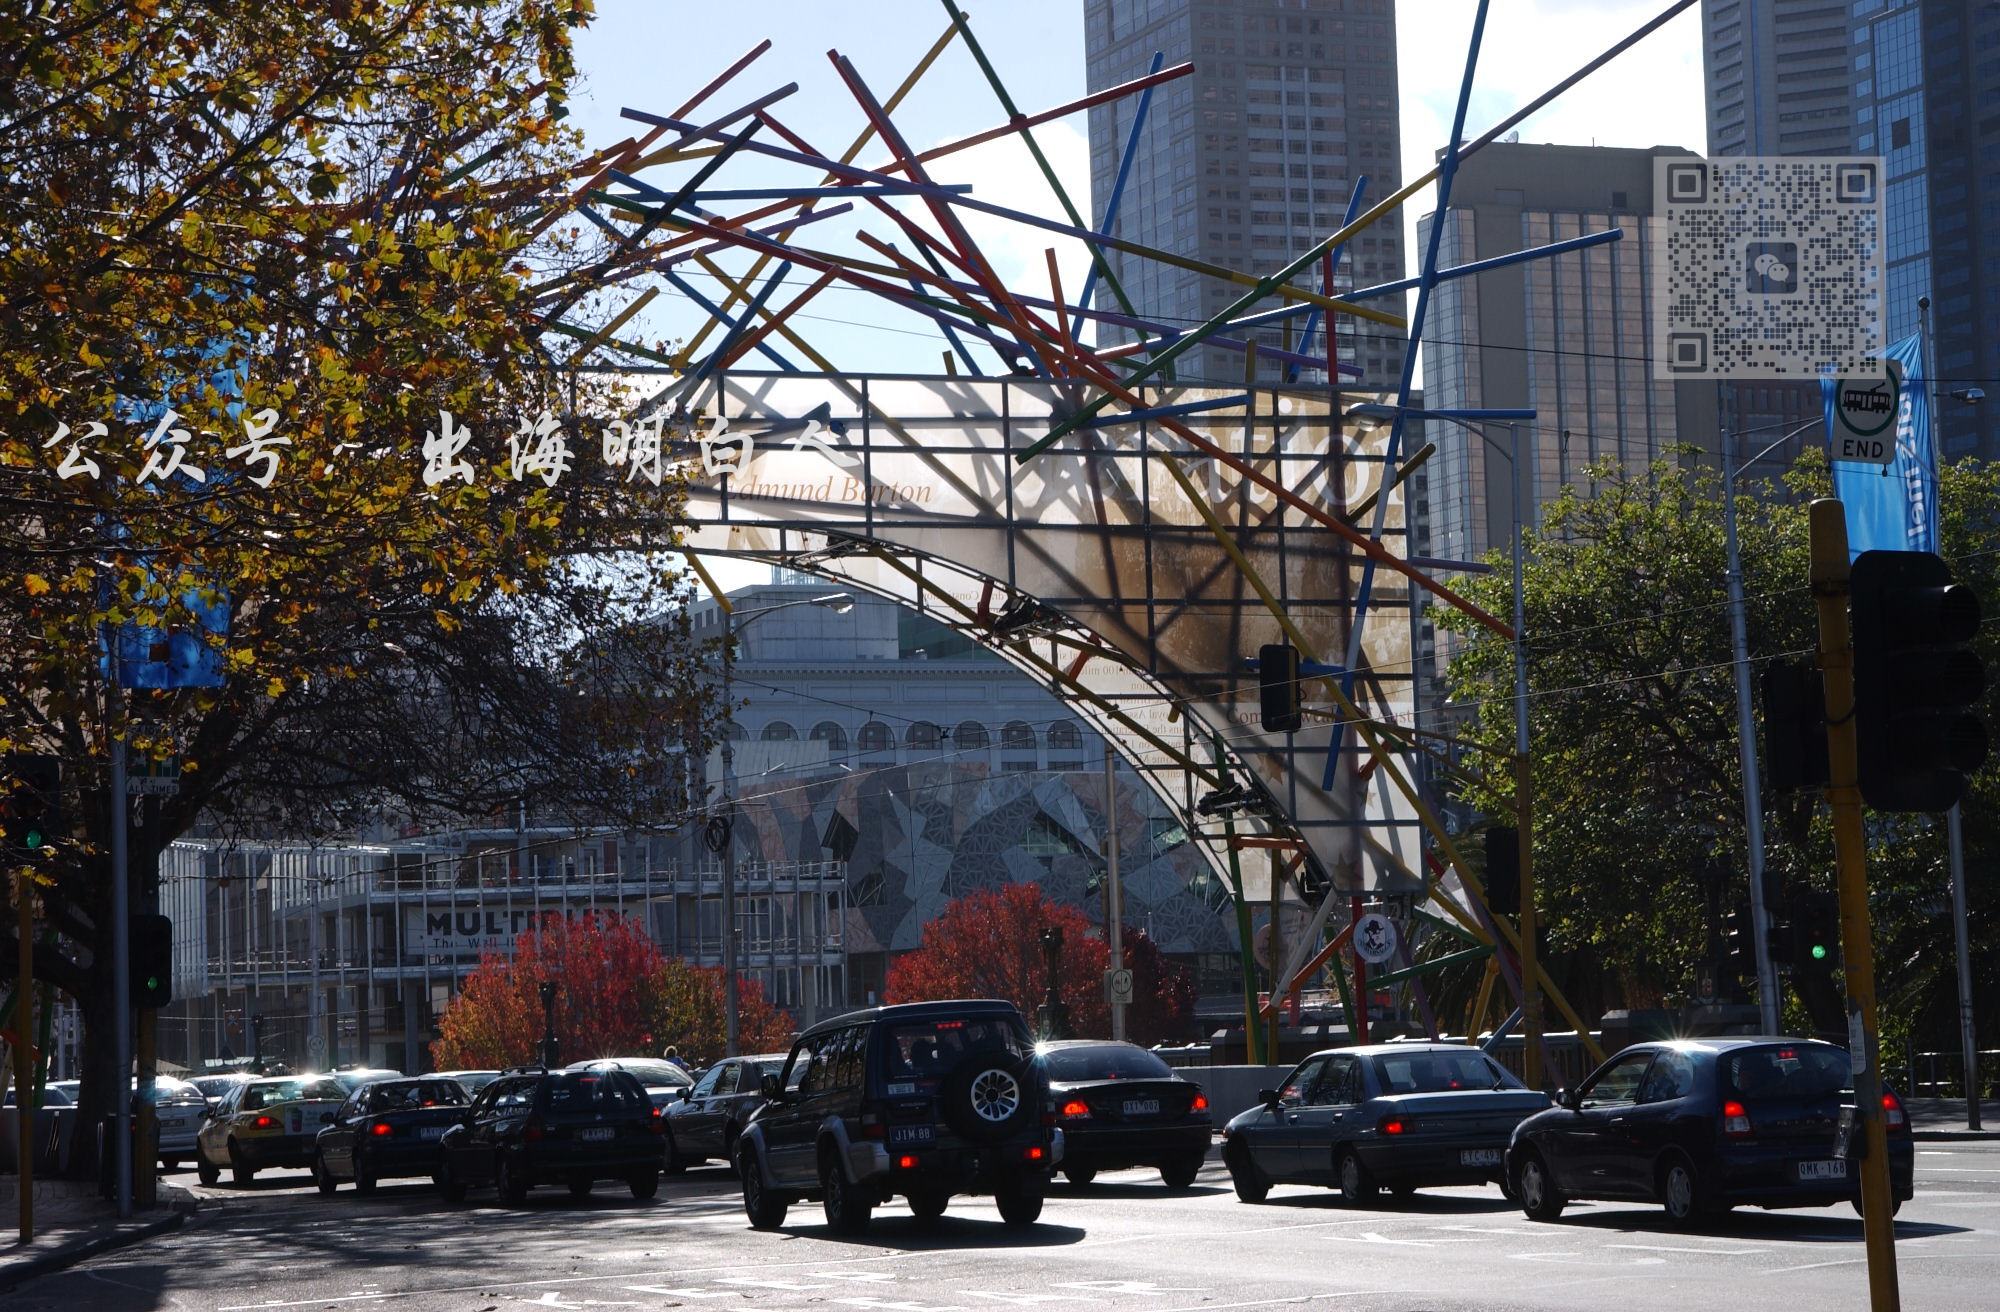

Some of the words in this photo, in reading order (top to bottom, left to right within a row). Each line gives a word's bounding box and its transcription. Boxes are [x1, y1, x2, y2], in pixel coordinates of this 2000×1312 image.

[1842, 438, 1884, 459] END
[720, 474, 835, 503] Edmund
[841, 475, 933, 504] Barton
[128, 784, 145, 793] ALL
[152, 783, 178, 794] TIMES
[427, 909, 629, 936] MULTI
